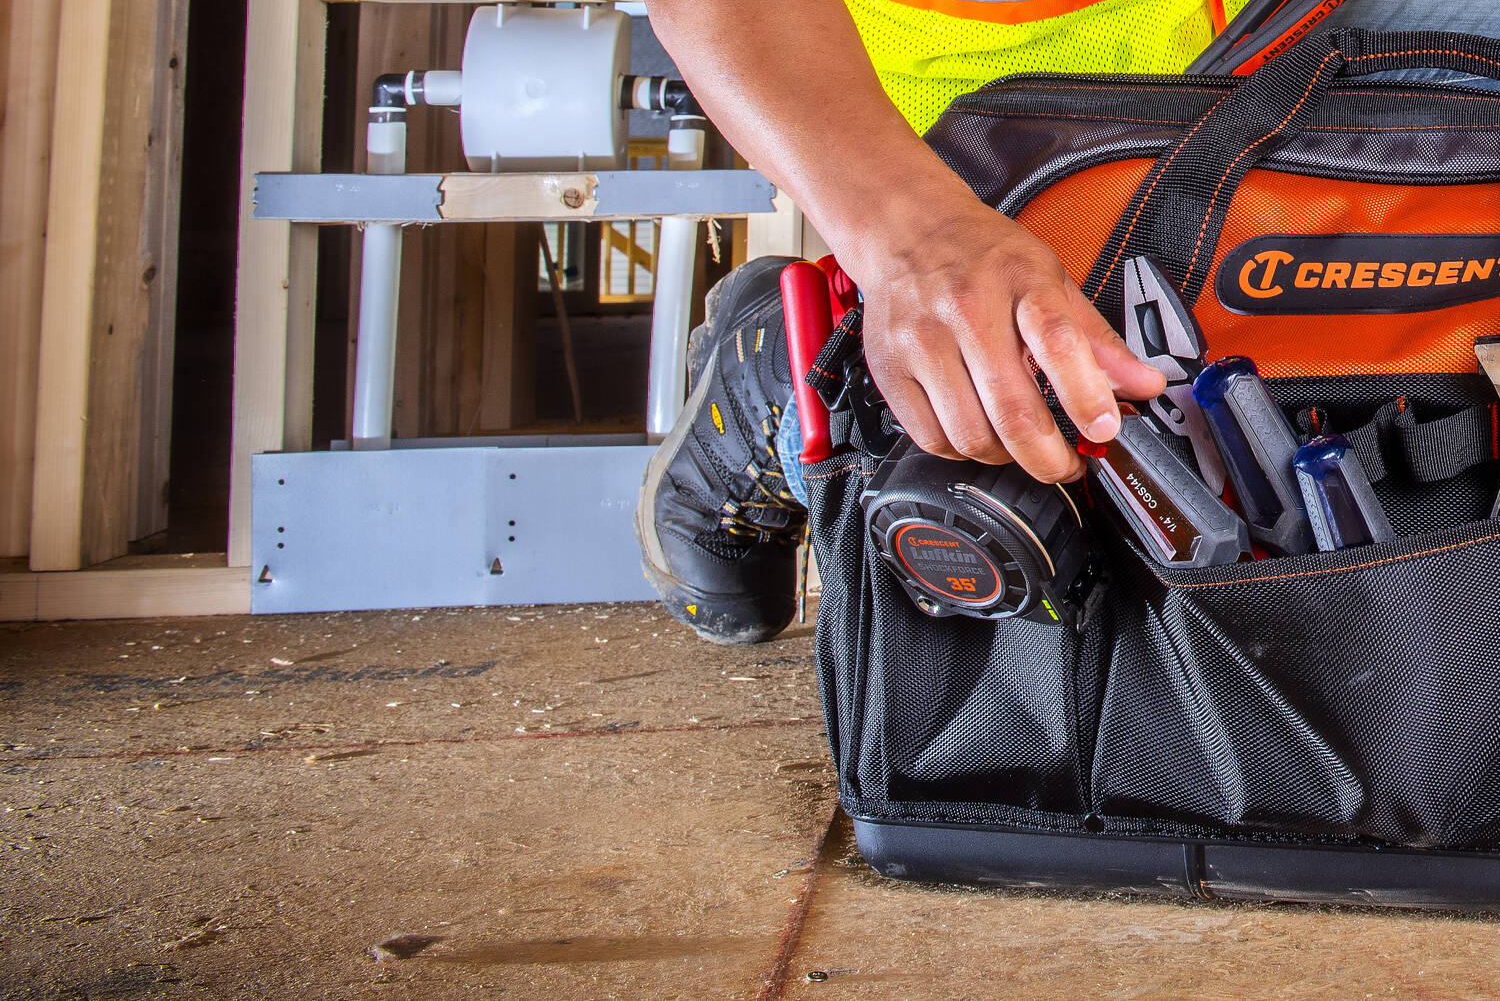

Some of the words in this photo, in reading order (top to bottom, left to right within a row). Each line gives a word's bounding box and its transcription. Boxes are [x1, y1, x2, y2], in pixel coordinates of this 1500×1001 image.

[1262, 10, 1326, 62] CRESCENT
[1126, 473, 1157, 509] CGS144
[1159, 515, 1177, 533] 1/4"
[917, 540, 960, 548] CRESCENT
[911, 548, 978, 563] Lufkin
